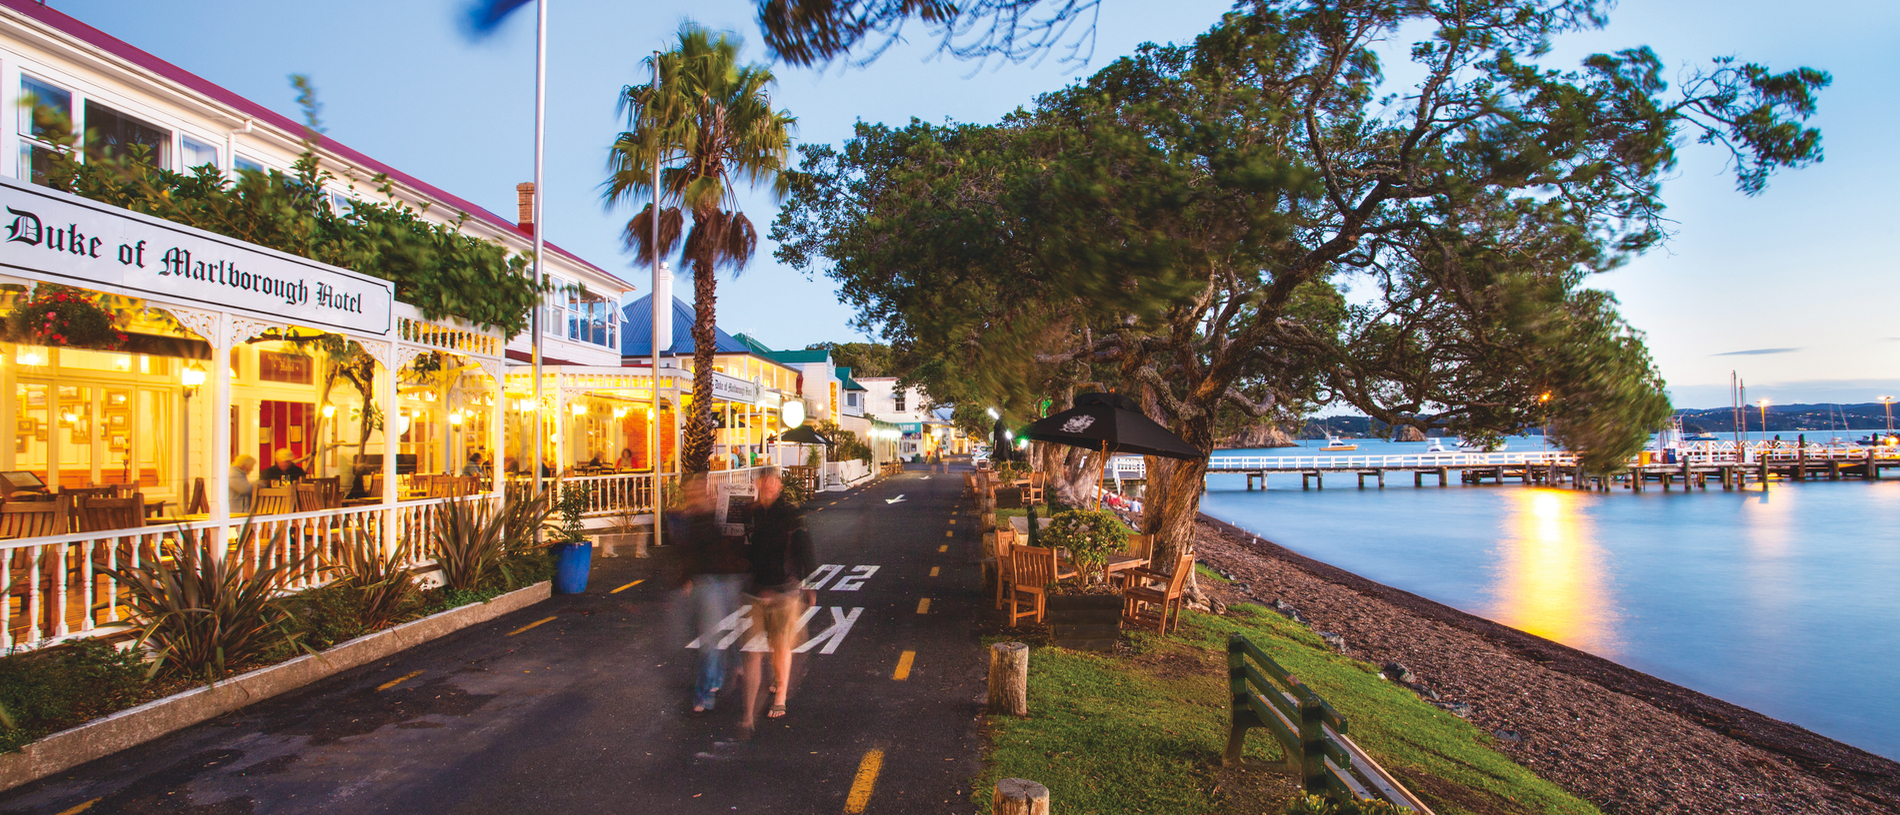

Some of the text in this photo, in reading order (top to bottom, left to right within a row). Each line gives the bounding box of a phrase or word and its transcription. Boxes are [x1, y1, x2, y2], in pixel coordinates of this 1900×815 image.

[4, 205, 363, 315] Duke of Marlborough Hotel
